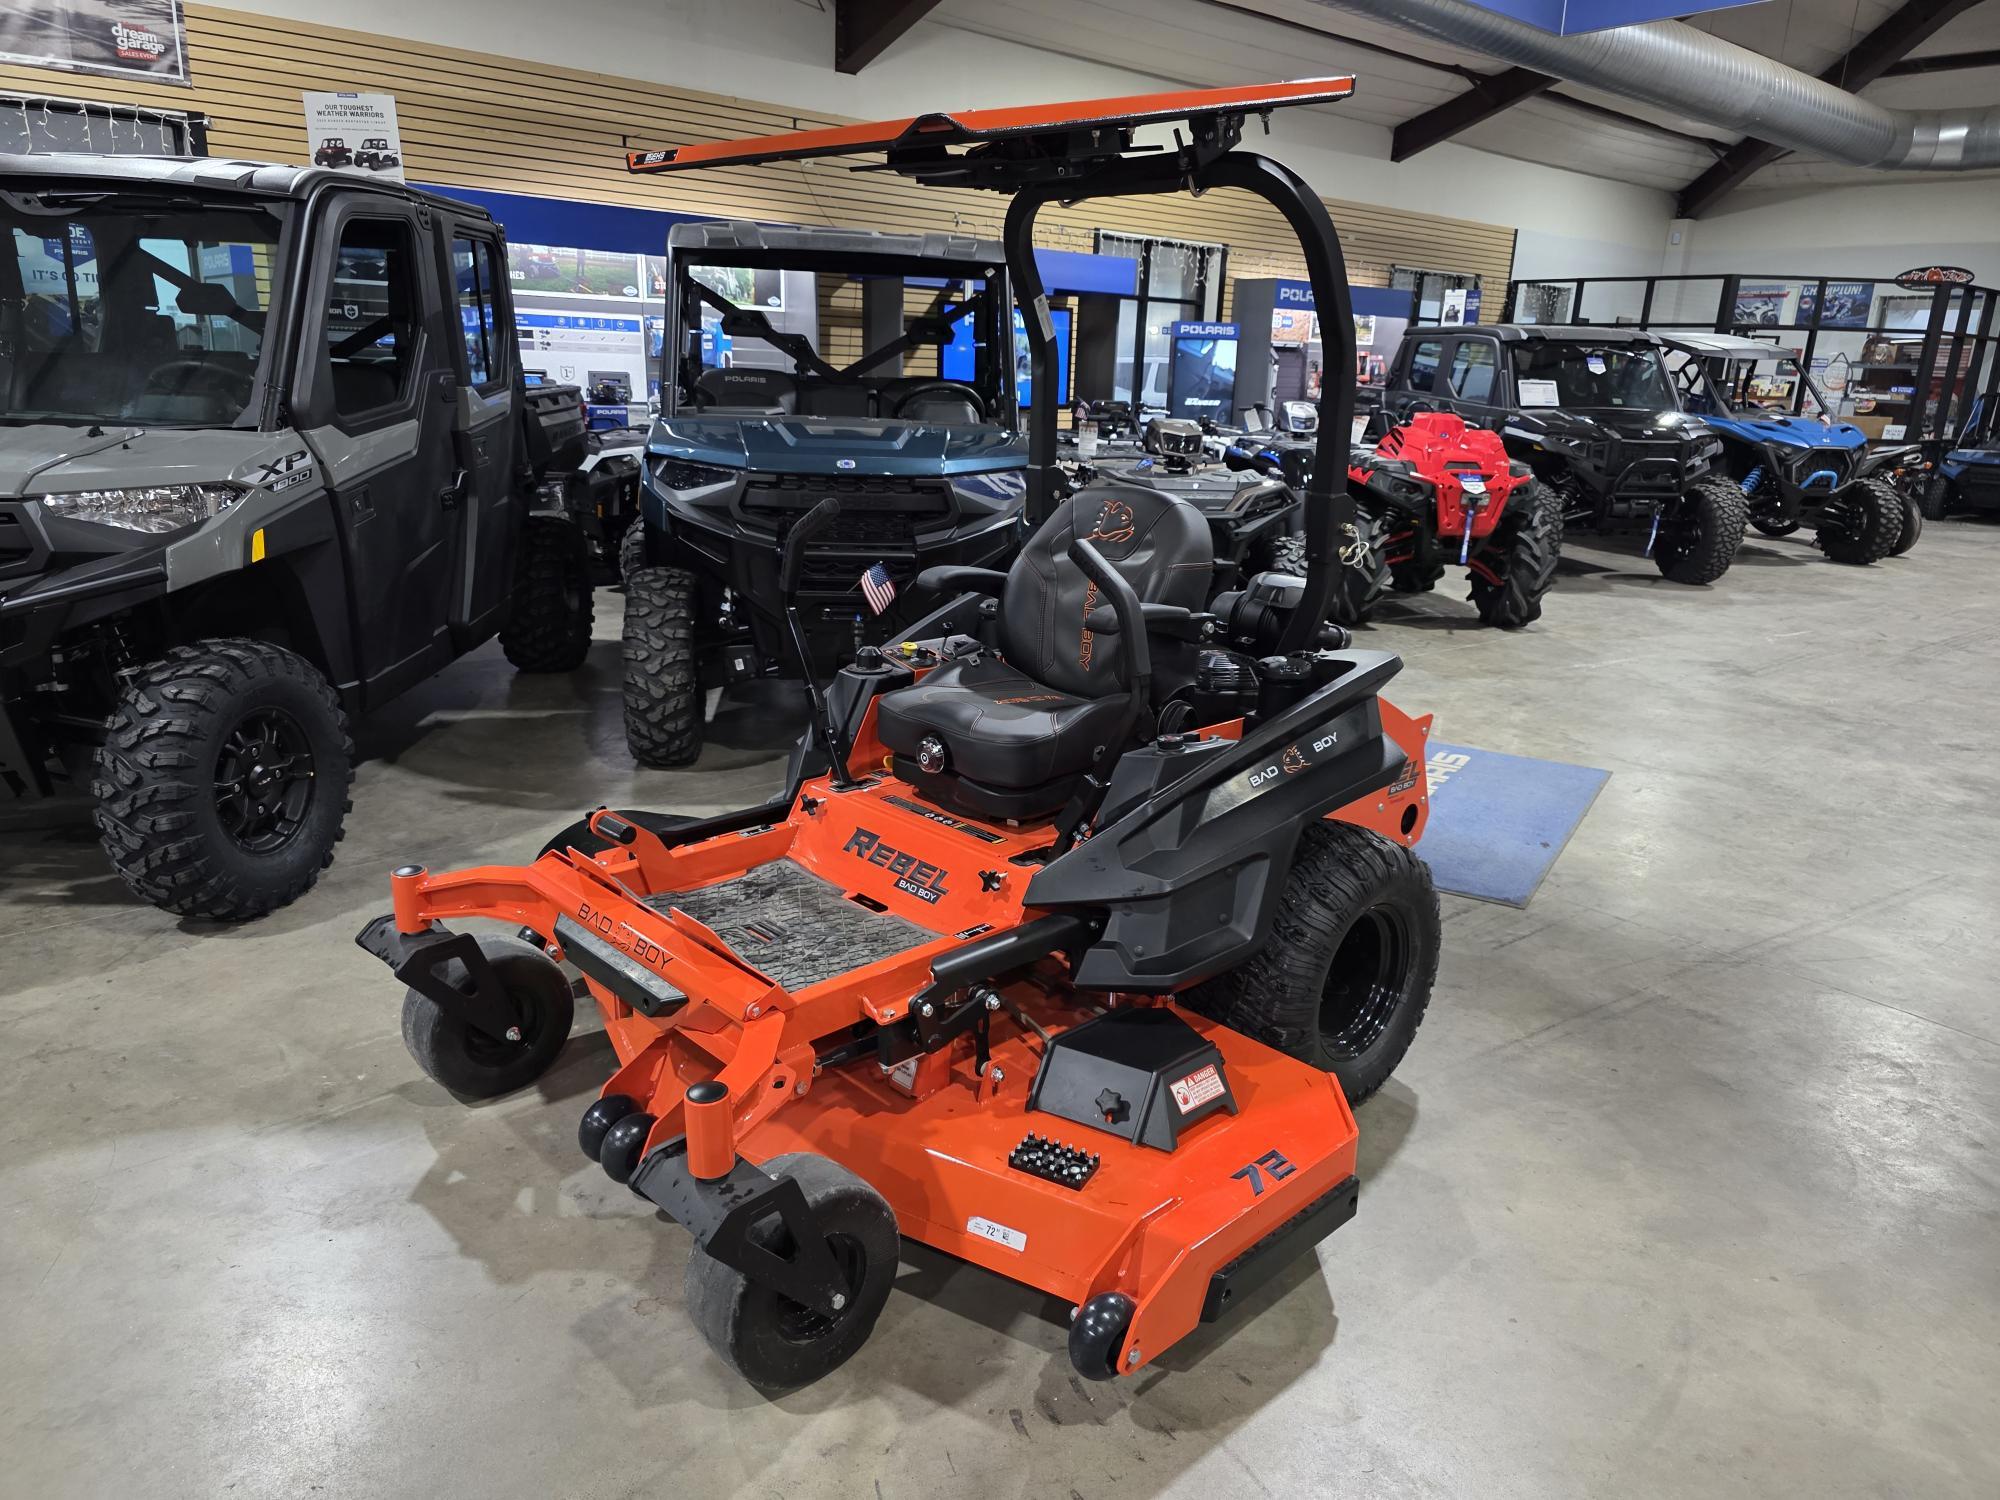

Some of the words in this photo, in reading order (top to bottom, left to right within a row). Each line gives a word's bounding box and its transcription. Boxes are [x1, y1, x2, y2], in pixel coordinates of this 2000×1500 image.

[111, 22, 158, 43] dream
[116, 36, 165, 55] garage
[339, 104, 374, 112] TOUGHEST
[349, 111, 385, 119] WARRIORS
[32, 269, 58, 281] IT'S
[1280, 287, 1315, 303] POLA
[1180, 324, 1236, 336] POLARIS
[724, 375, 767, 384] POLARIS
[257, 449, 309, 484] XP
[1079, 627, 1096, 673] BOY
[1248, 764, 1280, 788] BAD
[1311, 731, 1339, 753] BOY
[1390, 783, 1403, 794] BAD
[842, 826, 950, 897] REBEL
[898, 879, 917, 894] BAD
[918, 887, 938, 902] BOY
[577, 902, 613, 934] BAD
[633, 937, 674, 970] BOY
[1193, 1066, 1216, 1083] DANGER
[1230, 1148, 1298, 1198] 72
